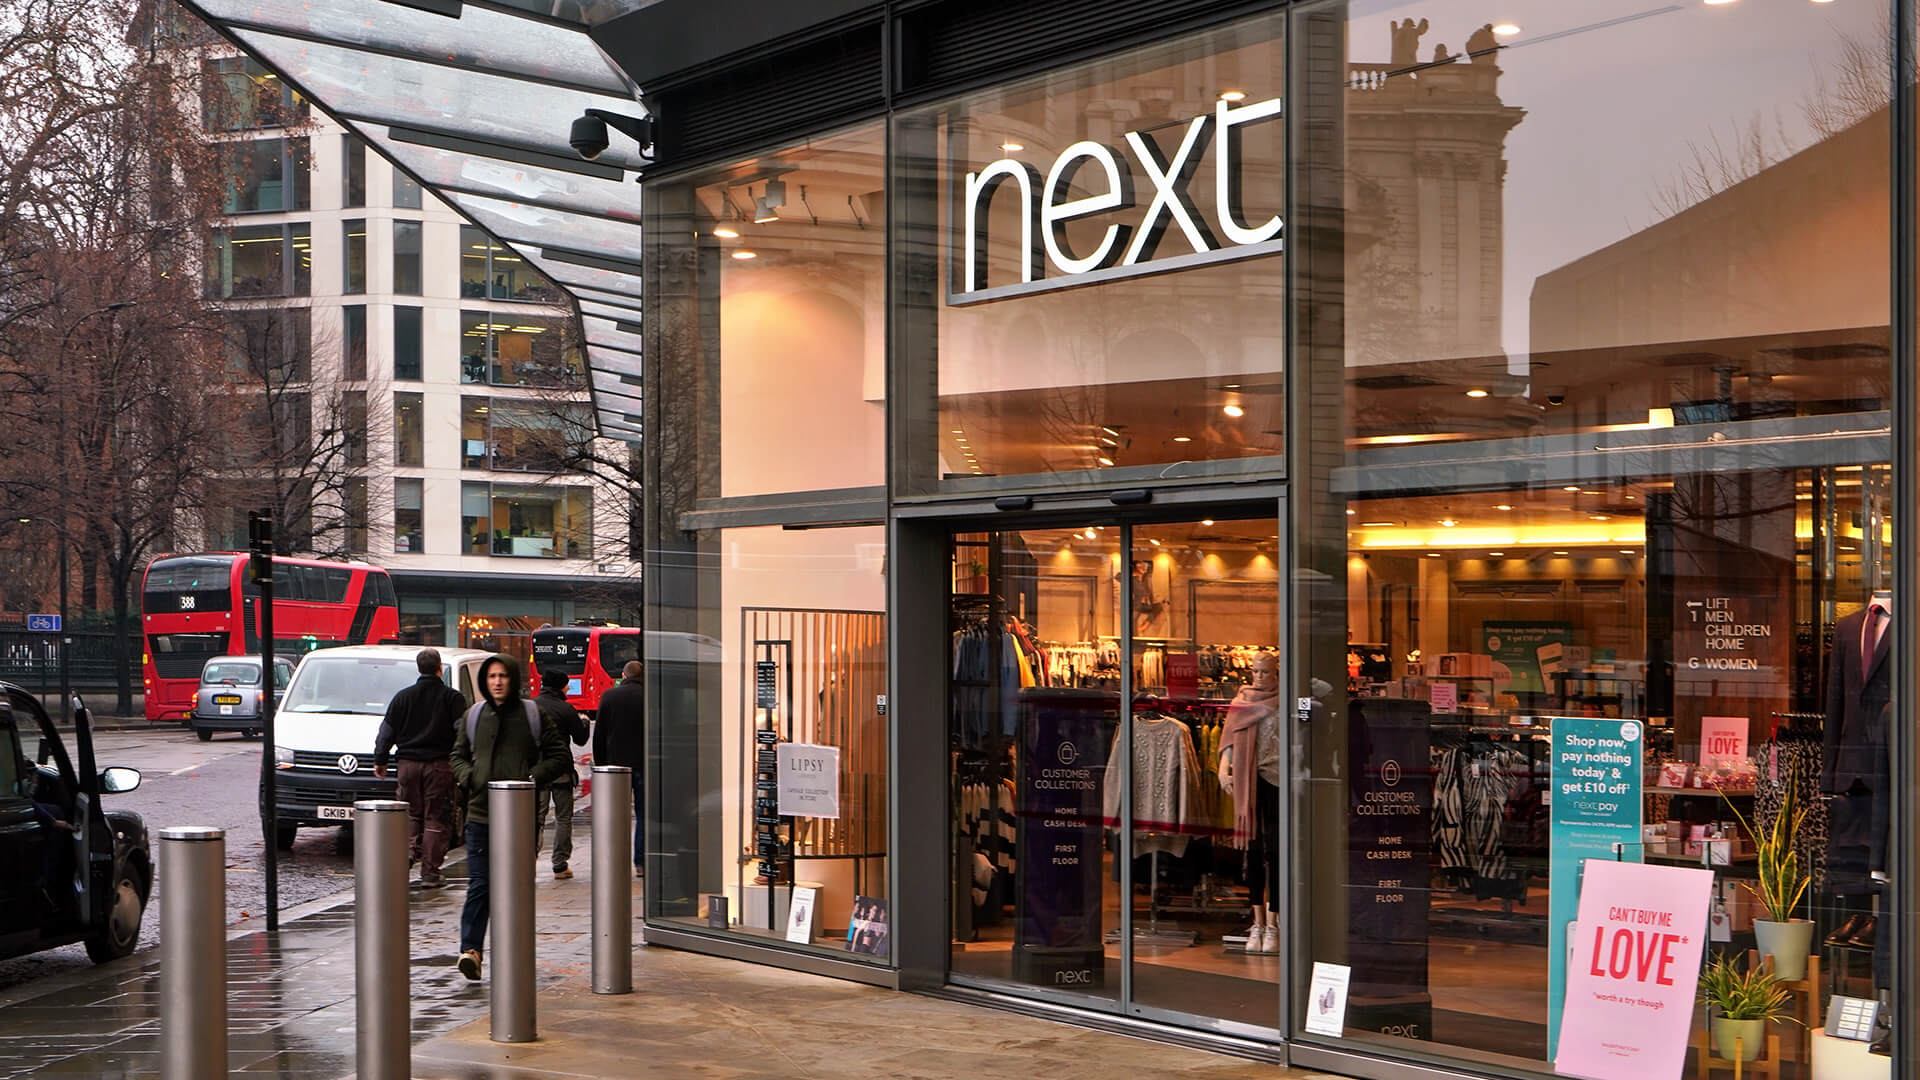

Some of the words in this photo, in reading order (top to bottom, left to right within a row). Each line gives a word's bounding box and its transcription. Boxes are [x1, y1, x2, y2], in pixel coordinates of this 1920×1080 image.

[965, 98, 1283, 293] next
[180, 596, 195, 609] 388
[1706, 598, 1730, 609] LIFT
[1690, 610, 1697, 622] 1
[1705, 611, 1734, 622] MEN
[1705, 624, 1771, 636] CHILDREN
[557, 644, 568, 655] 521
[1705, 638, 1745, 650] HOME
[1688, 657, 1700, 669] G
[1704, 658, 1758, 670] WOMEN
[1565, 734, 1596, 749] Shop
[1598, 739, 1627, 750] now,
[791, 758, 824, 772] LIPSY
[1561, 752, 1583, 764] pay
[1585, 751, 1632, 767] nothing
[1041, 769, 1090, 779] CUSTOMER
[1611, 767, 1622, 779] &
[1034, 780, 1096, 790] COLLECTIONS
[1562, 782, 1582, 794] get
[1584, 781, 1607, 793] £10
[1364, 791, 1415, 803] CUSTOMER
[1054, 807, 1078, 815] HOME
[1356, 804, 1421, 815] COLLECTIONS
[1043, 819, 1066, 828] CASH
[1378, 836, 1402, 845] HOME
[1054, 844, 1077, 853] FIRST
[1052, 857, 1079, 865] FLOOR
[1366, 851, 1391, 860] CASH
[1391, 851, 1413, 860] DESK
[1378, 879, 1402, 889] FIRST
[1375, 894, 1404, 903] FLOOR
[1609, 906, 1637, 922] CAN'T
[1638, 909, 1658, 926] BUY
[1658, 911, 1673, 927] ME
[1055, 969, 1091, 984] next
[1624, 996, 1636, 1007] try
[1637, 997, 1665, 1011] though
[1381, 1024, 1419, 1038] next
